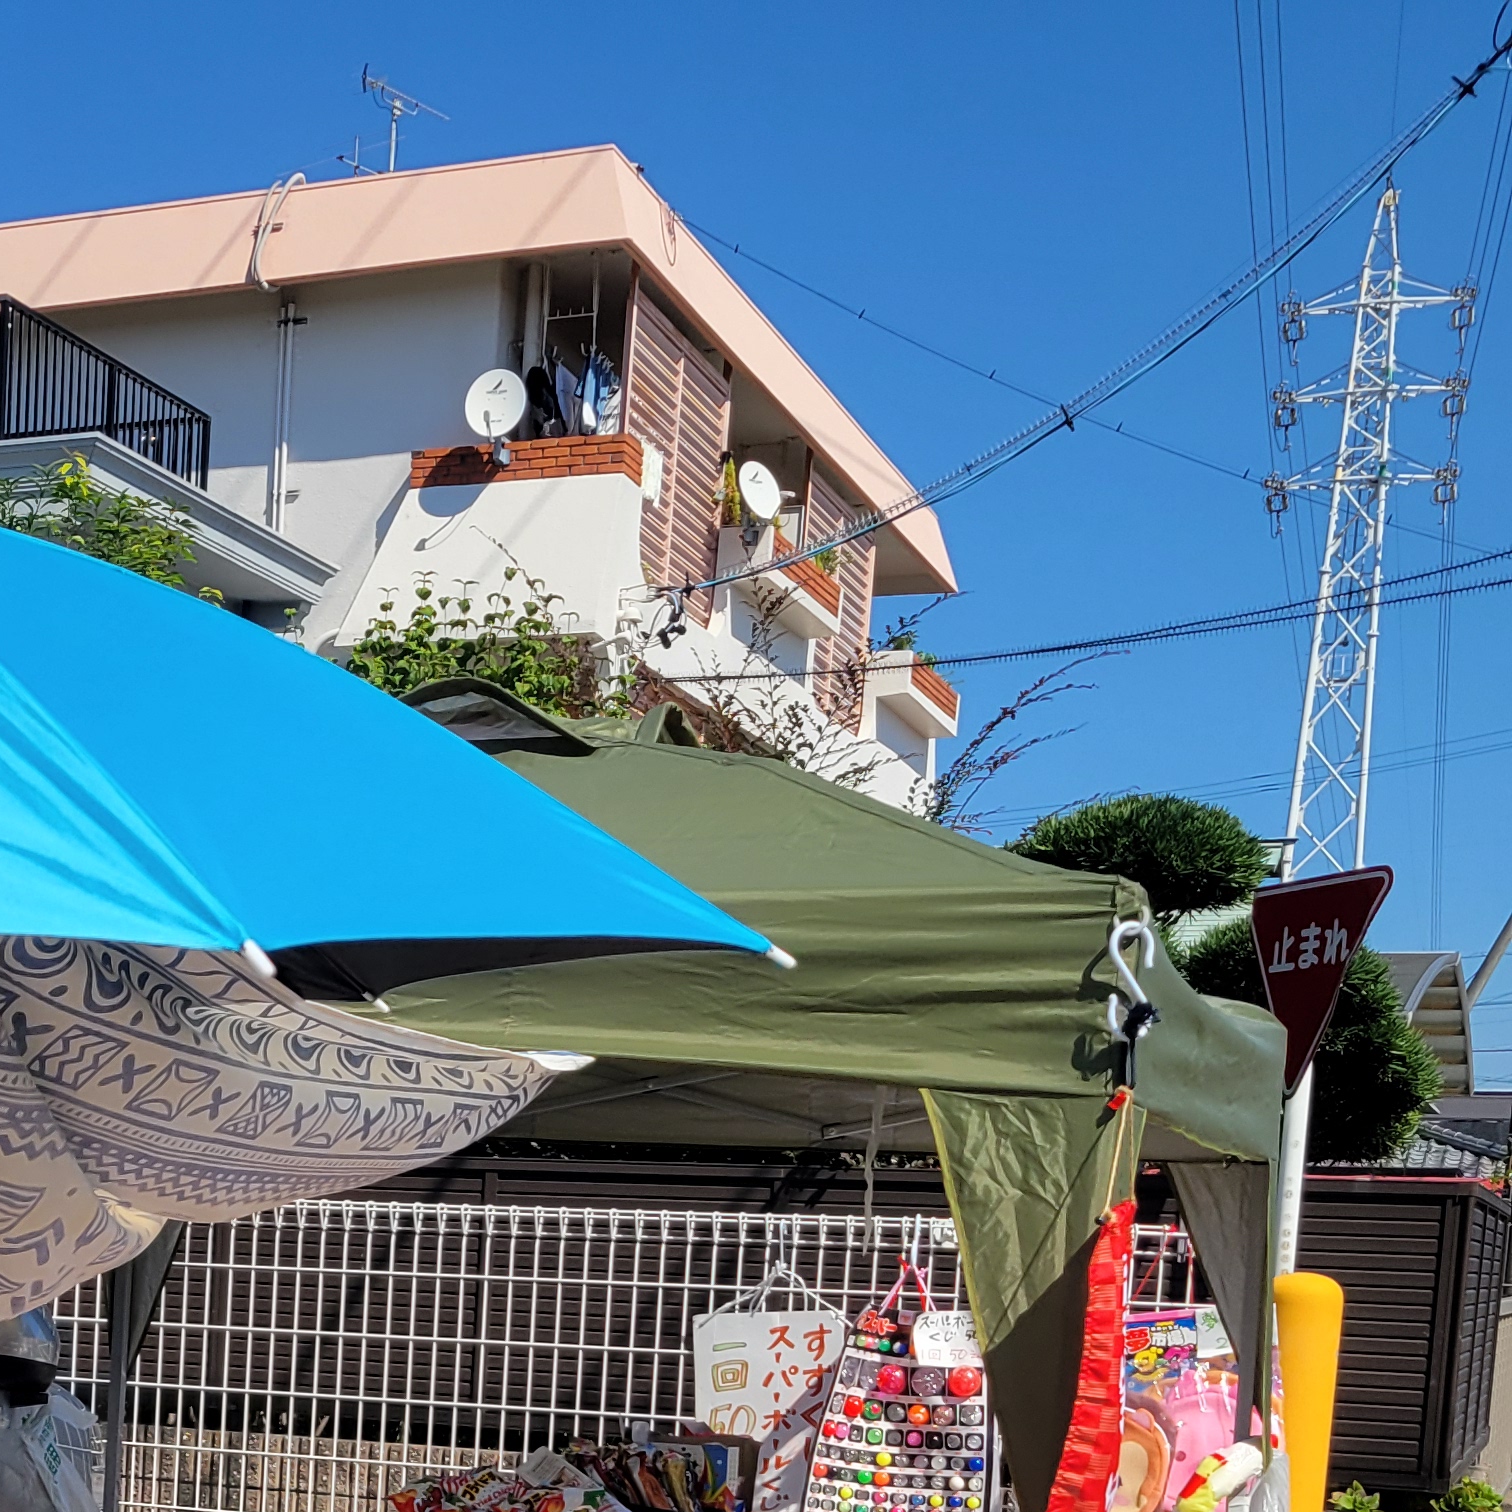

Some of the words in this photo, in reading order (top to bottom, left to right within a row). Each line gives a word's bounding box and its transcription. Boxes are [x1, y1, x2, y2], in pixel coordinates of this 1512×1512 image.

[1268, 918, 1349, 973] 止まれ
[760, 1326, 799, 1511] スーパーボールくじ
